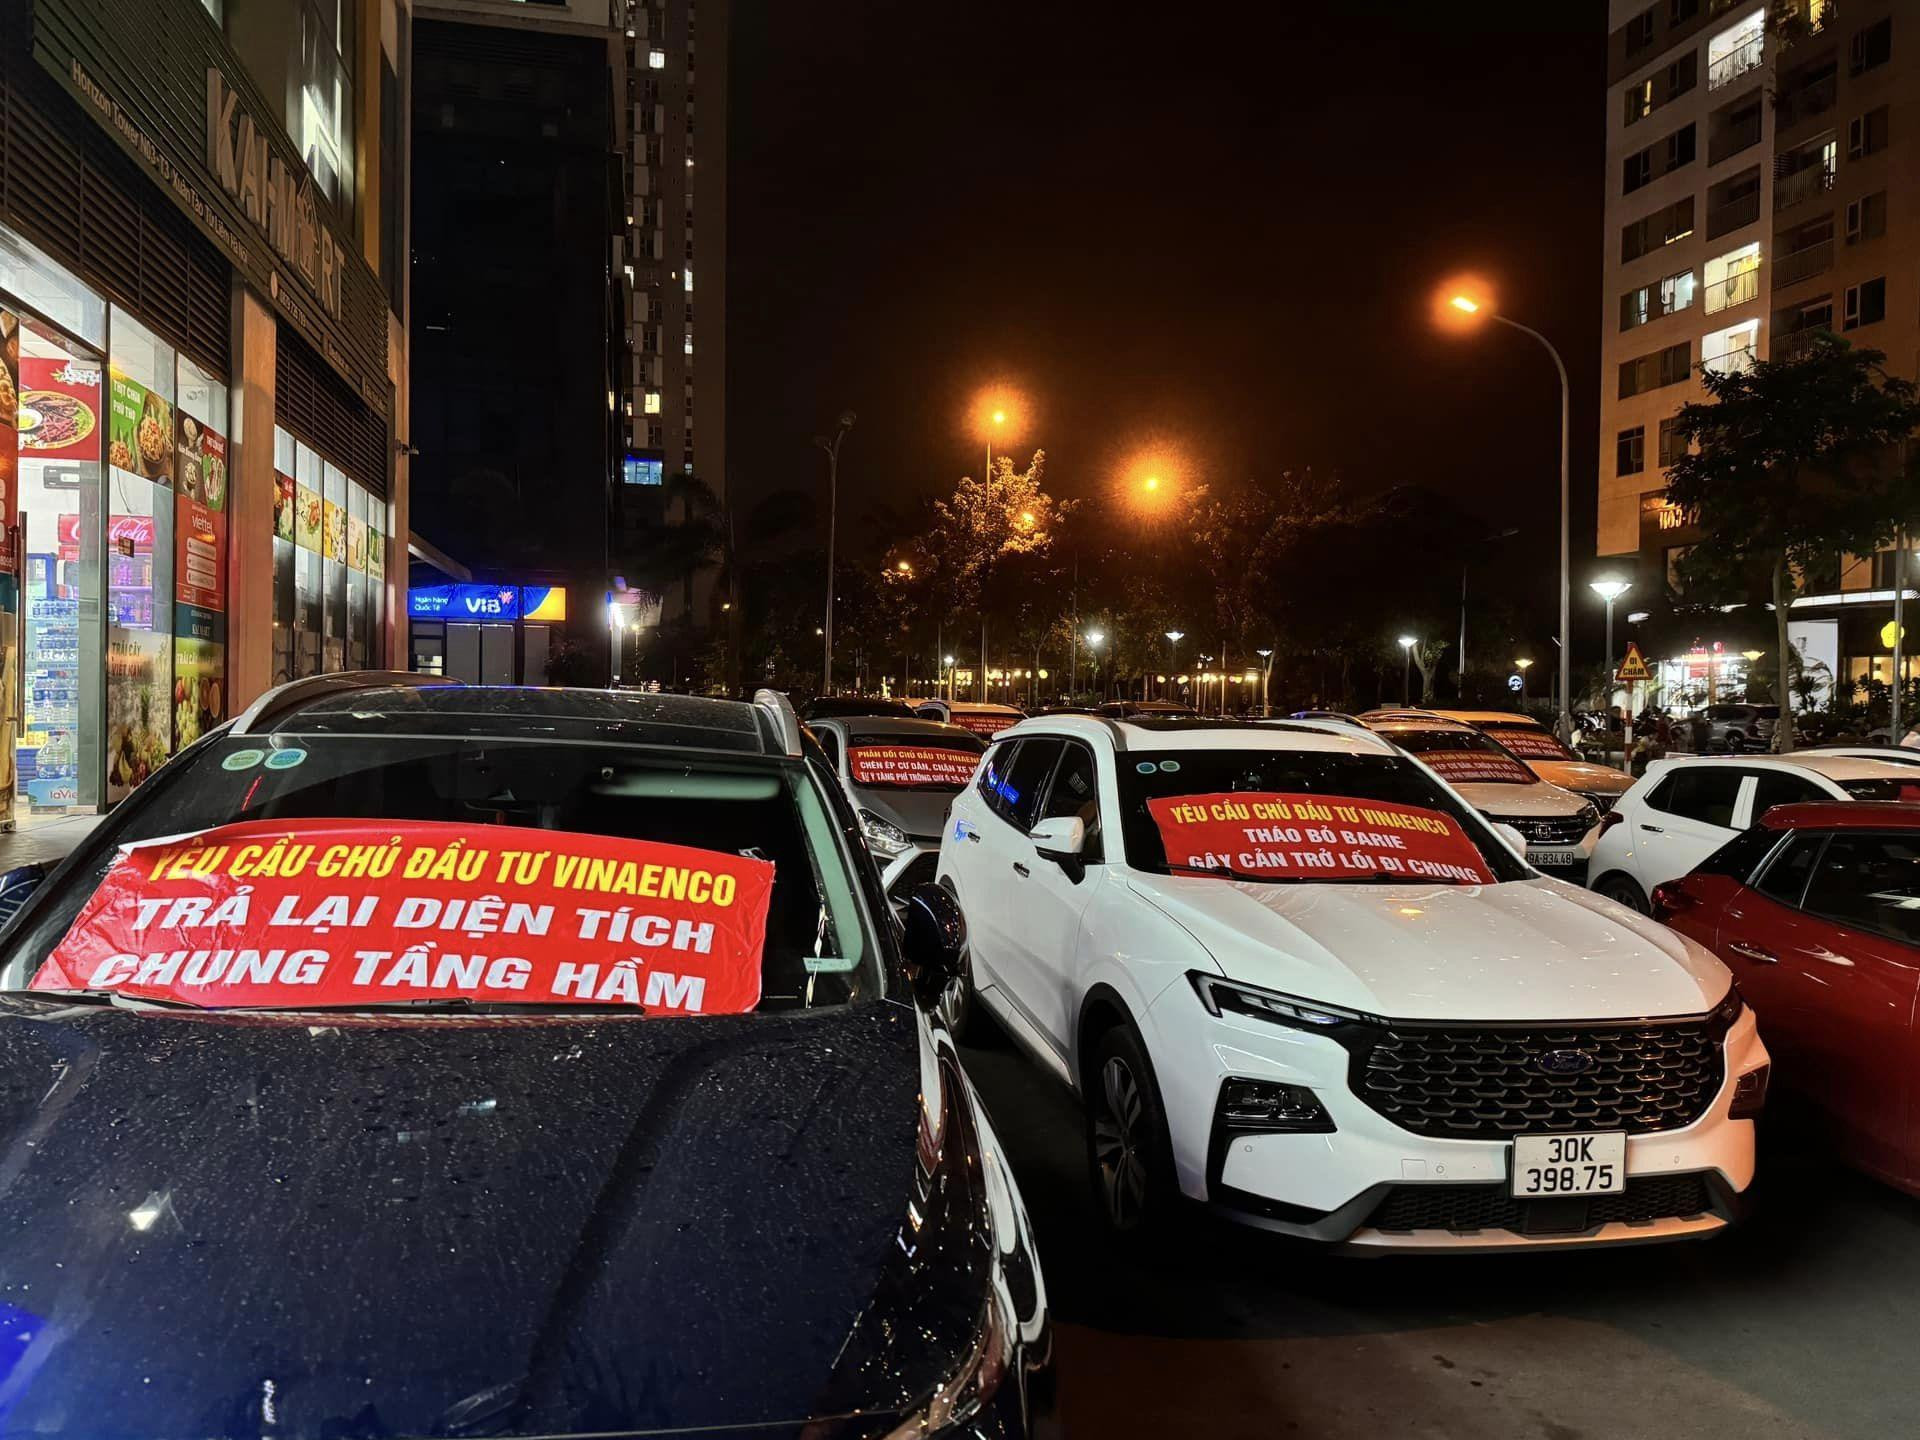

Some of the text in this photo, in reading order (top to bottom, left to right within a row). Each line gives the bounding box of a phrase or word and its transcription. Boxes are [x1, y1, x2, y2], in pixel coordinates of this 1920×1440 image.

[72, 57, 111, 117] Horizon
[112, 100, 138, 145] Tower
[858, 750, 881, 759] PHẢN
[899, 750, 915, 760] CHỦ
[917, 751, 933, 761] ĐẦU
[936, 752, 946, 761] TƯ
[897, 761, 909, 769] CƯ
[956, 764, 967, 772] XE
[1170, 798, 1451, 837] YÊU CẦU CHỦ ĐẦU TƯ VINAENCO
[1243, 825, 1408, 850] THÁO BỎ BARIE
[149, 832, 737, 907] YÊU CẦU CHỦ ĐẦU TƯ VINAENCO
[1189, 848, 1482, 884] GÂY CẢN TRỞ LỐI ĐI CHUNG
[131, 885, 715, 954] TRẢ LẠI DIỆN TÍCH
[88, 941, 706, 1013] CHUNG TẦNG HẦM
[1548, 1137, 1594, 1164] 30K
[1526, 1164, 1613, 1194] 398.75
